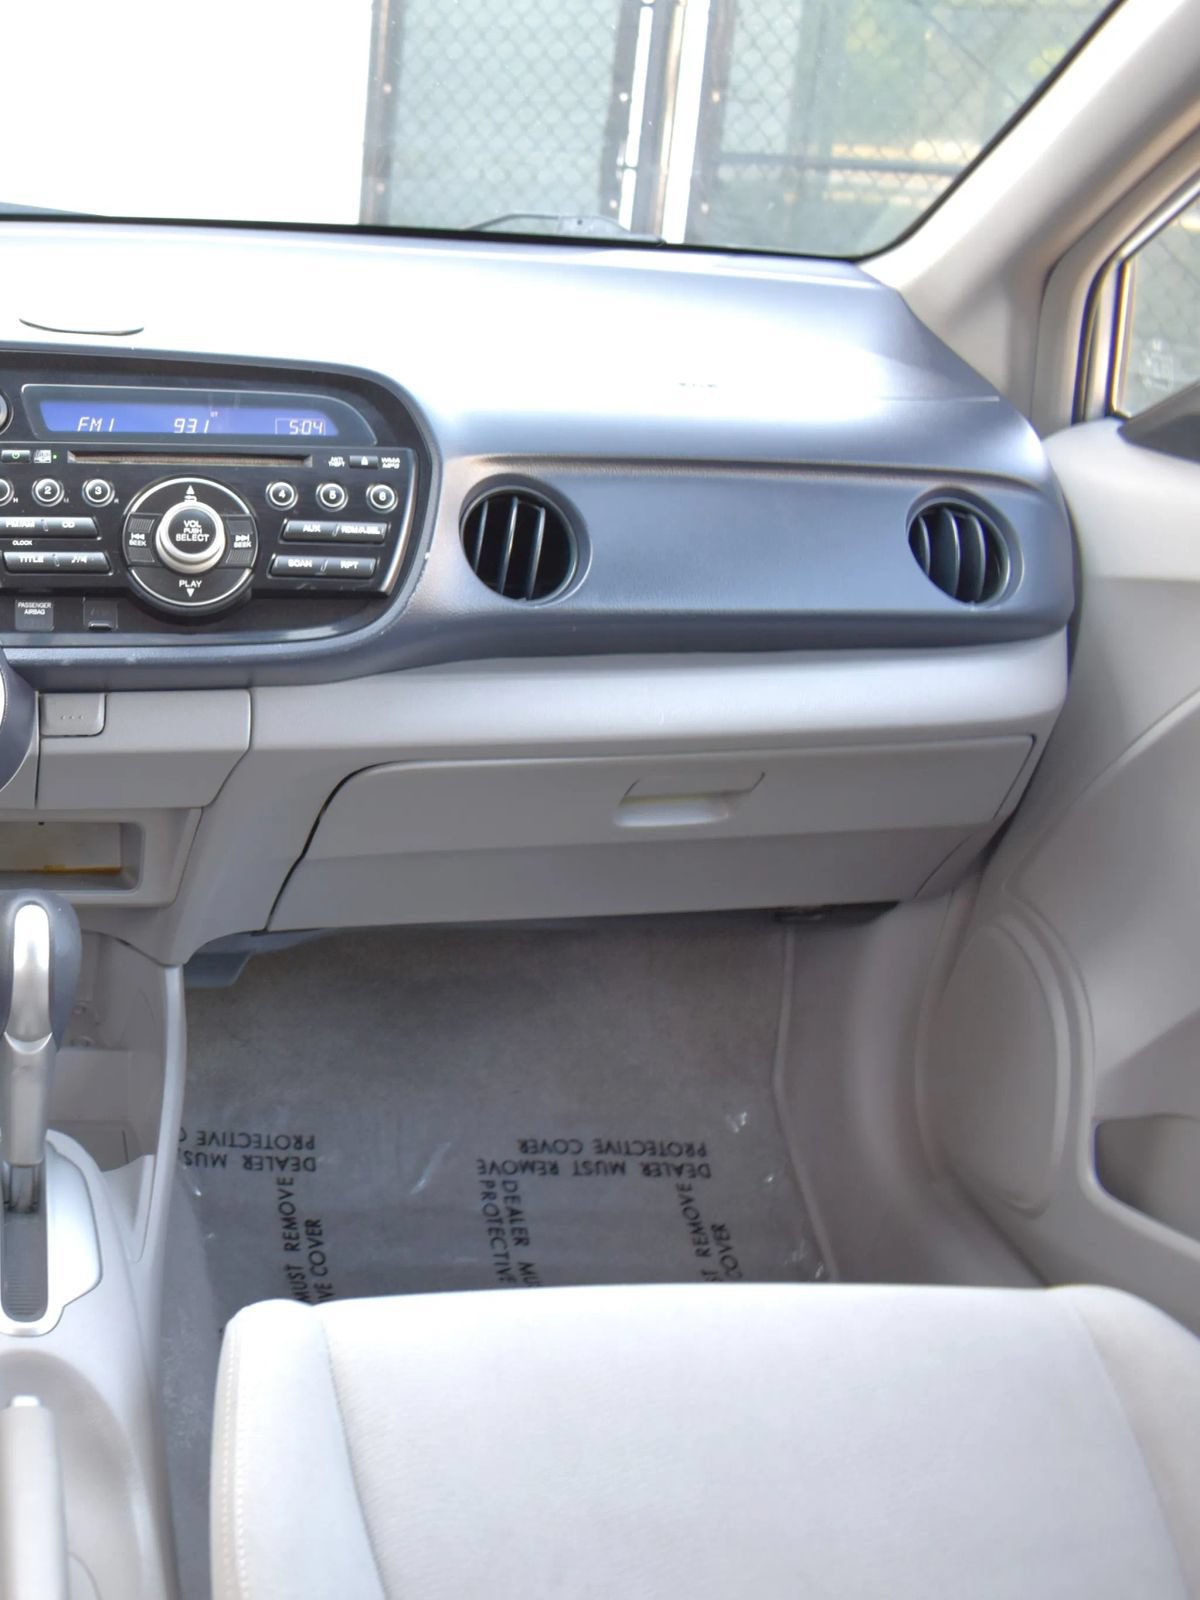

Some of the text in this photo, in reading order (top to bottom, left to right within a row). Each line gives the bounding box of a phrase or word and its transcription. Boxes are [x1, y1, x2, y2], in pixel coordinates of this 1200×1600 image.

[44, 487, 51, 495] 2
[94, 487, 102, 495] 3
[279, 490, 286, 498] 4
[329, 491, 337, 499] 5
[379, 493, 386, 501] 6
[183, 520, 202, 528] VOL
[303, 525, 321, 533] AUX
[176, 534, 209, 542] SELECT
[196, 1130, 315, 1150] PROTECTIVE
[517, 1138, 708, 1157] PROTECTIVE COVER
[180, 1149, 317, 1172] DEALER MUS
[476, 1158, 712, 1179] DEALER MUST REMOVE
[277, 1177, 301, 1252] REMOVE
[502, 1180, 531, 1247] DEALER
[675, 1183, 712, 1257] REMOVE
[304, 1219, 328, 1277] COVER
